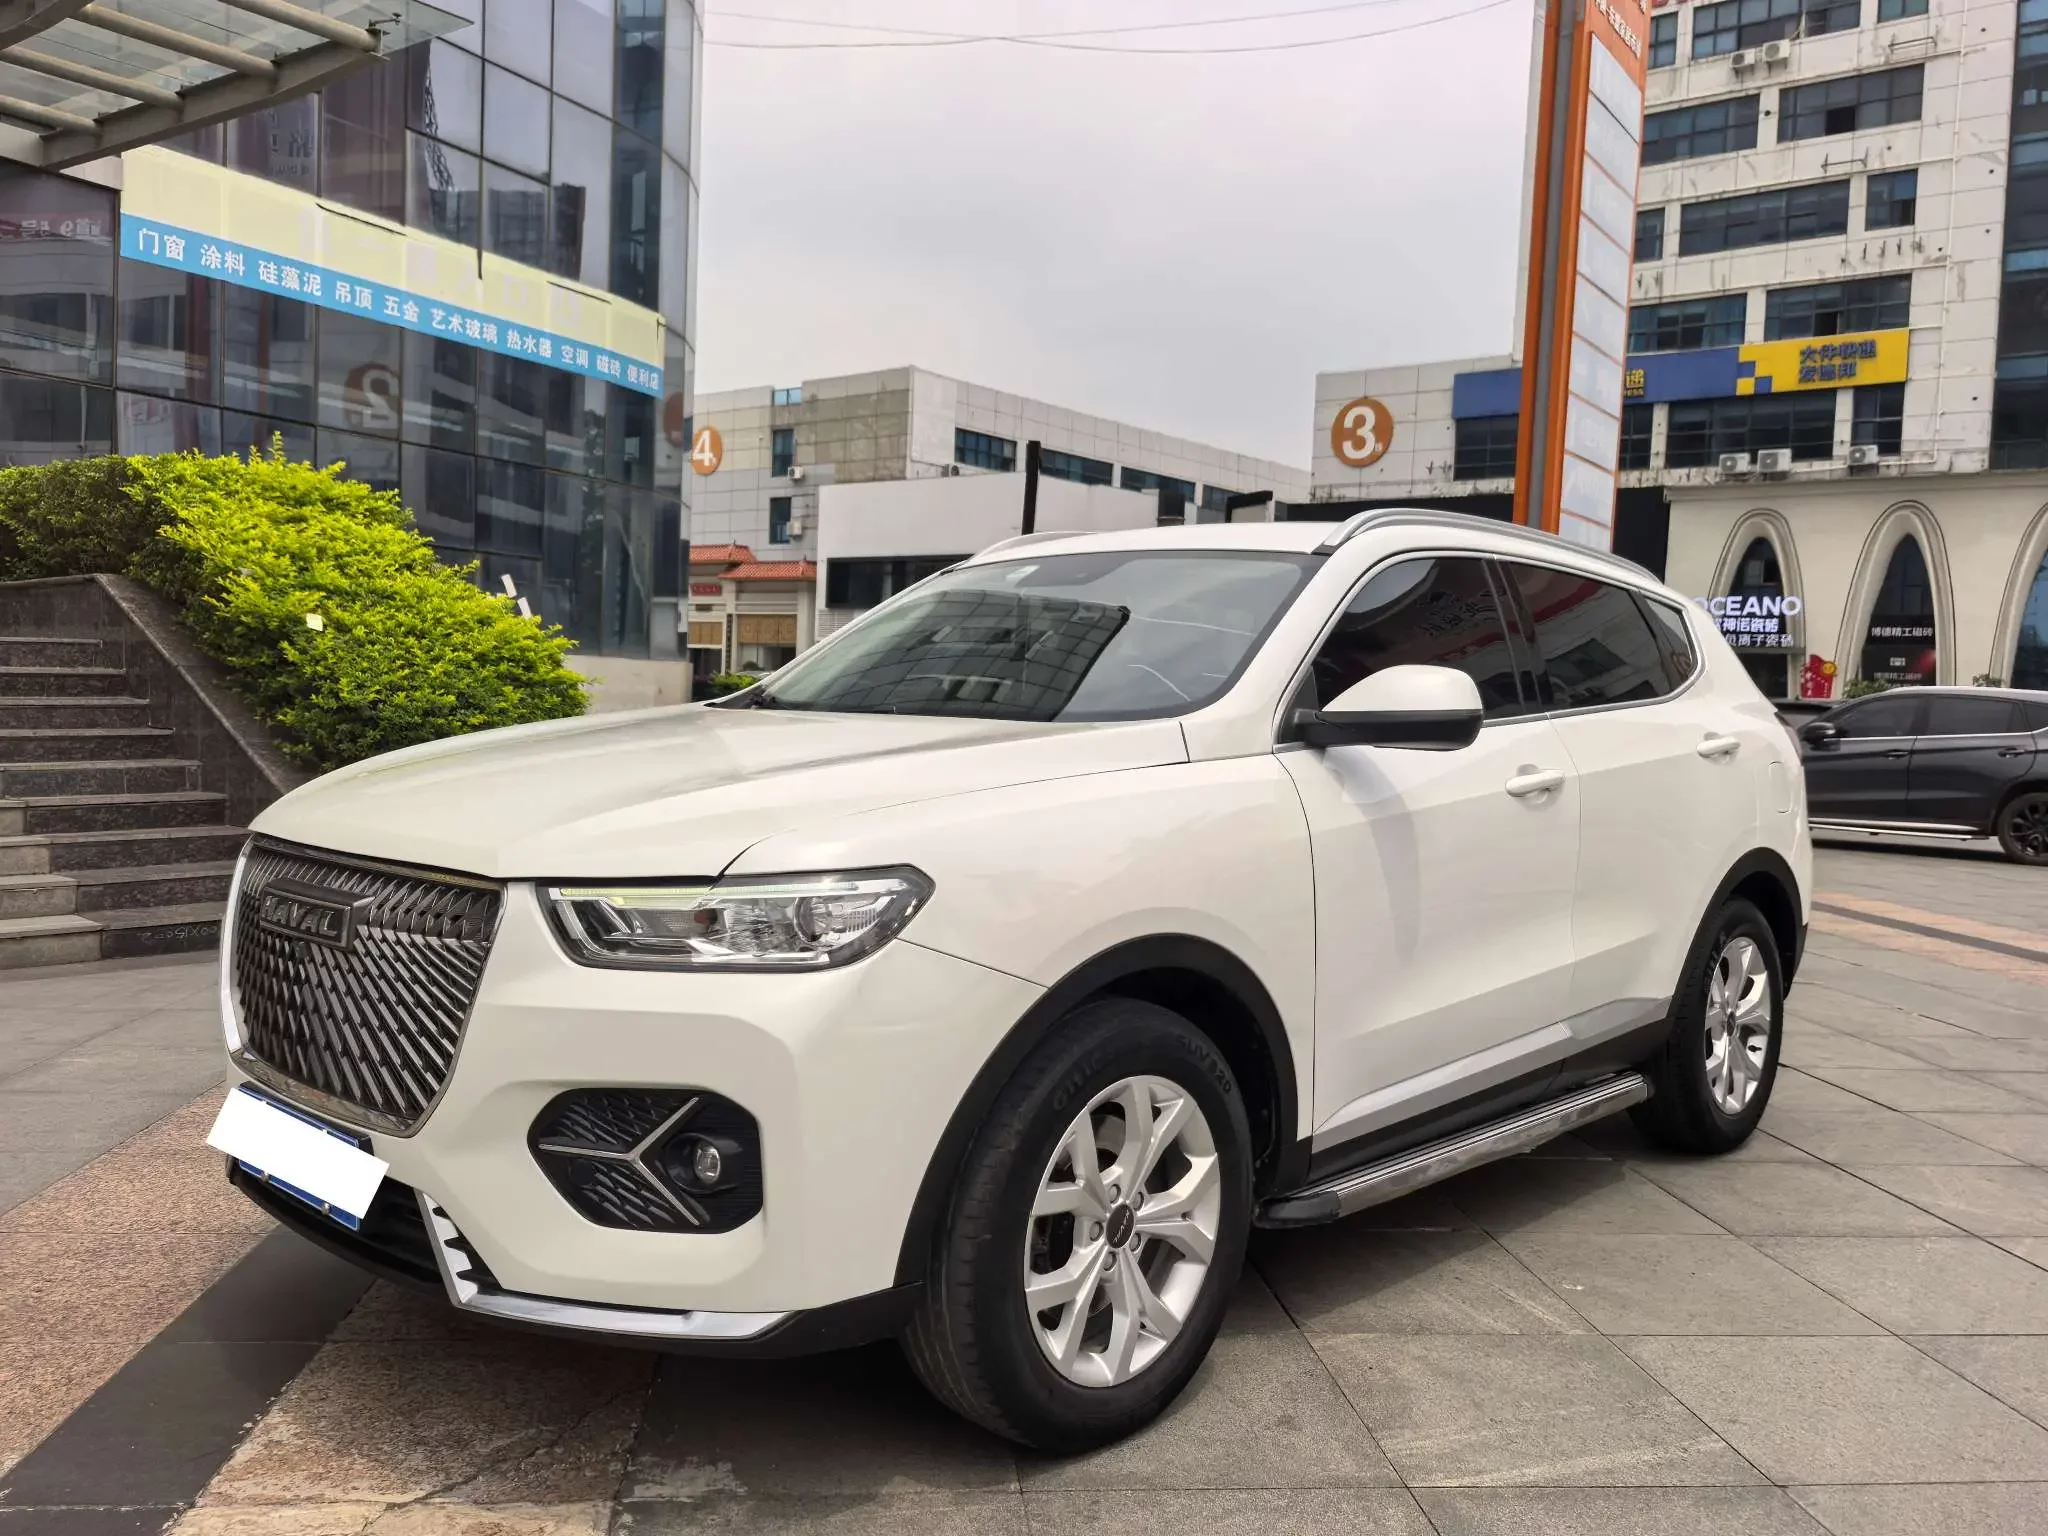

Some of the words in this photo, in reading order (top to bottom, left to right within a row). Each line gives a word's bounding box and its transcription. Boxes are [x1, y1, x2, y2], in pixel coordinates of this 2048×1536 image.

[138, 228, 185, 261] 门窗
[200, 244, 245, 276] 涂料
[258, 259, 322, 297] 硅藻泥
[335, 280, 373, 310] 吊顶
[383, 294, 419, 323] 五金
[430, 307, 498, 345] 艺术玻璃
[693, 430, 713, 467] 4
[1342, 405, 1375, 459] 3
